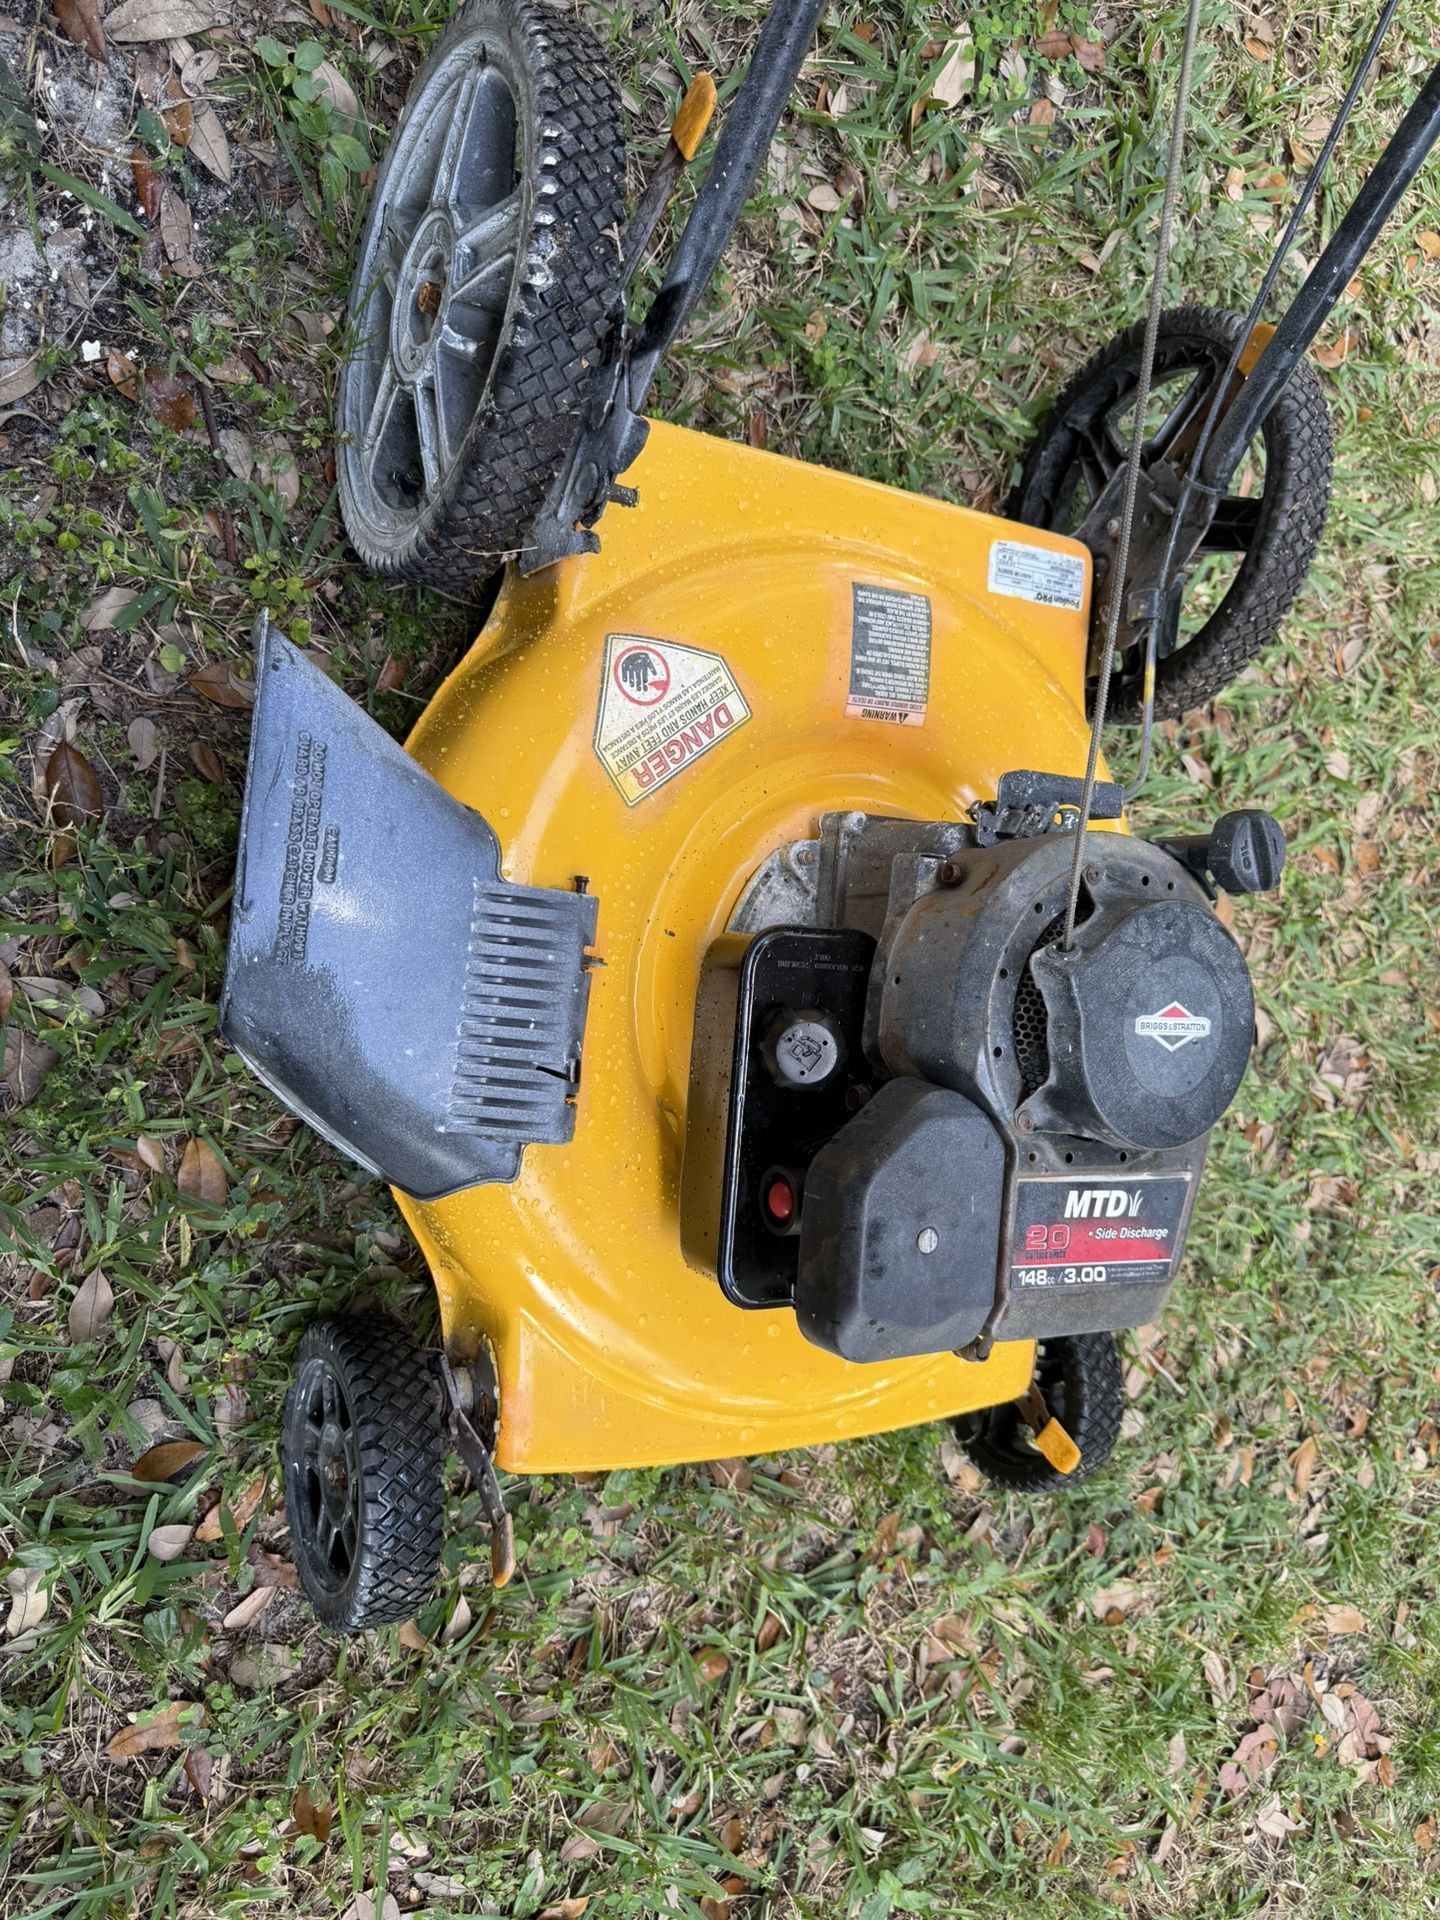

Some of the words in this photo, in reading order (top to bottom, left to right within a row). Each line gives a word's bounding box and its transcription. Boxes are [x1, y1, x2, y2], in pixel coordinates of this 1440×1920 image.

[1036, 592, 1053, 603] PRO
[1053, 595, 1079, 609] Poulan
[691, 664, 721, 689] MANTENGA
[700, 674, 723, 695] GARDEZ
[680, 684, 693, 697] LAS
[689, 689, 702, 702] LES
[706, 683, 729, 705] KEEP
[866, 697, 874, 705] OR
[657, 705, 664, 714] Y
[661, 692, 683, 711] MANOS
[673, 696, 692, 714] MAINS
[678, 697, 709, 725] HANDS
[873, 698, 889, 706] INJURY
[633, 716, 648, 731] PIES
[646, 708, 660, 722] LOS
[655, 714, 668, 727] LES
[666, 708, 676, 719] ET
[861, 708, 898, 719] WARNING
[639, 721, 658, 738] PIEDS
[660, 718, 680, 738] AND
[314, 741, 326, 759] DO
[601, 728, 631, 754] DISTANCIA
[608, 736, 637, 760] DISTANCE
[631, 702, 735, 789] DANGER
[639, 731, 662, 753] FEET
[297, 731, 311, 775] GUARD
[613, 746, 641, 772] AWAY
[311, 761, 324, 788] NOT
[290, 798, 305, 841] GRASS
[305, 790, 321, 850] OPERATE
[324, 826, 338, 882] CAUTION
[1240, 839, 1252, 870] OIL
[284, 843, 301, 905] CATCHER
[300, 852, 314, 898] MOWER
[293, 902, 309, 959] WITHOUT
[1064, 1189, 1129, 1218] MTD
[1025, 1224, 1071, 1251] 20
[1095, 1227, 1118, 1240] Side
[1119, 1226, 1169, 1241] Discharge
[1064, 1266, 1107, 1284] 3.00
